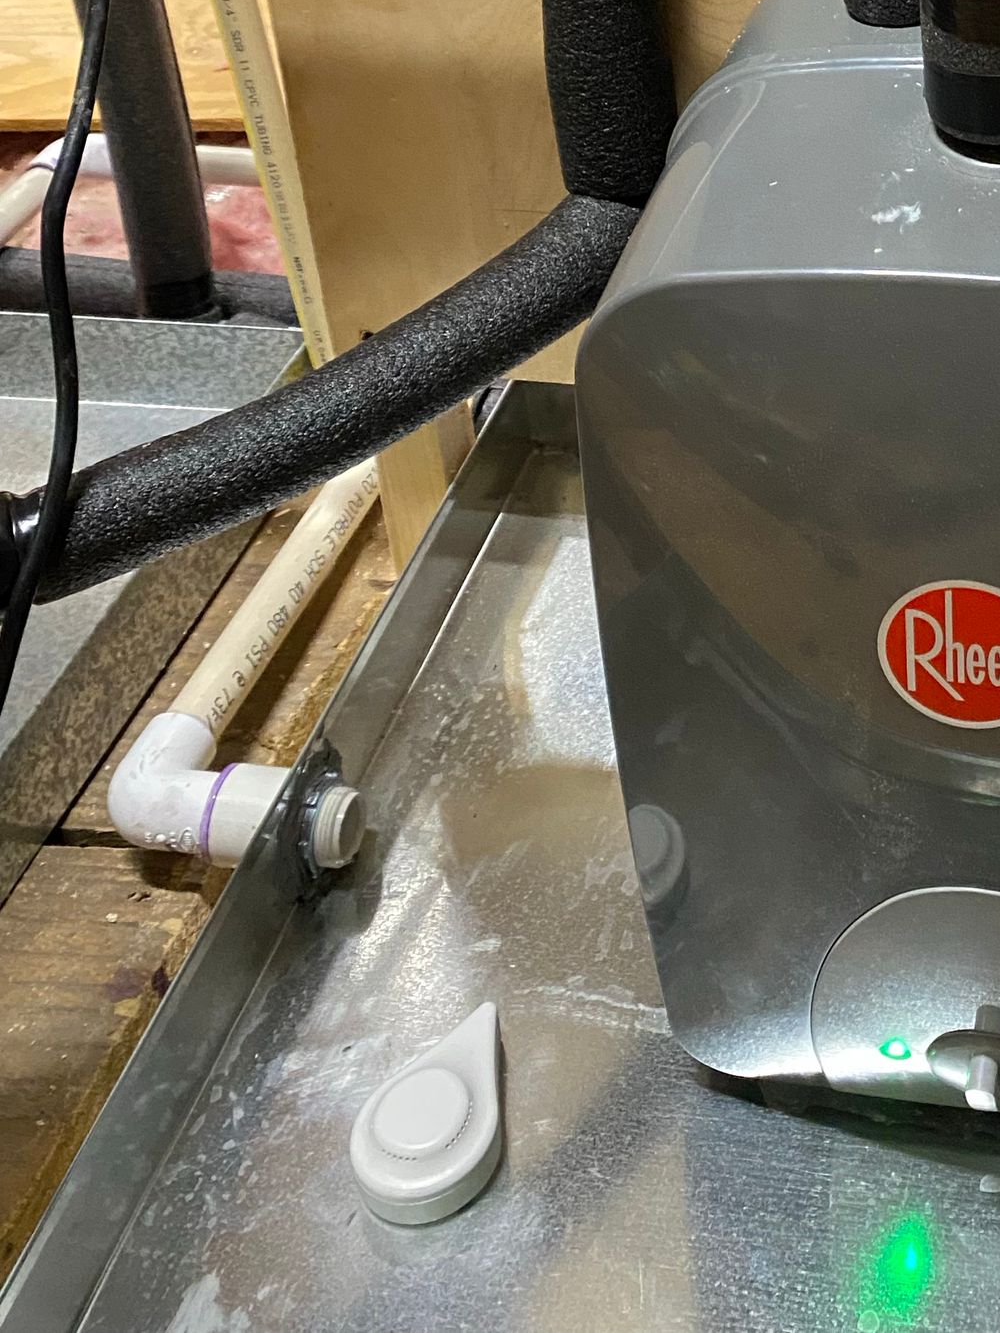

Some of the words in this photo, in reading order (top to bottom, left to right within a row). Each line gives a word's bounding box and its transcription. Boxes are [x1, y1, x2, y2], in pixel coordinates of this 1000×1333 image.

[244, 79, 259, 107] CPVC
[255, 115, 272, 155] TUBING
[267, 161, 282, 189] 4120
[322, 492, 364, 552] POTABLE
[303, 549, 326, 583] SCH
[288, 581, 304, 604] 40
[267, 605, 290, 636] 480
[245, 635, 269, 667] PSI
